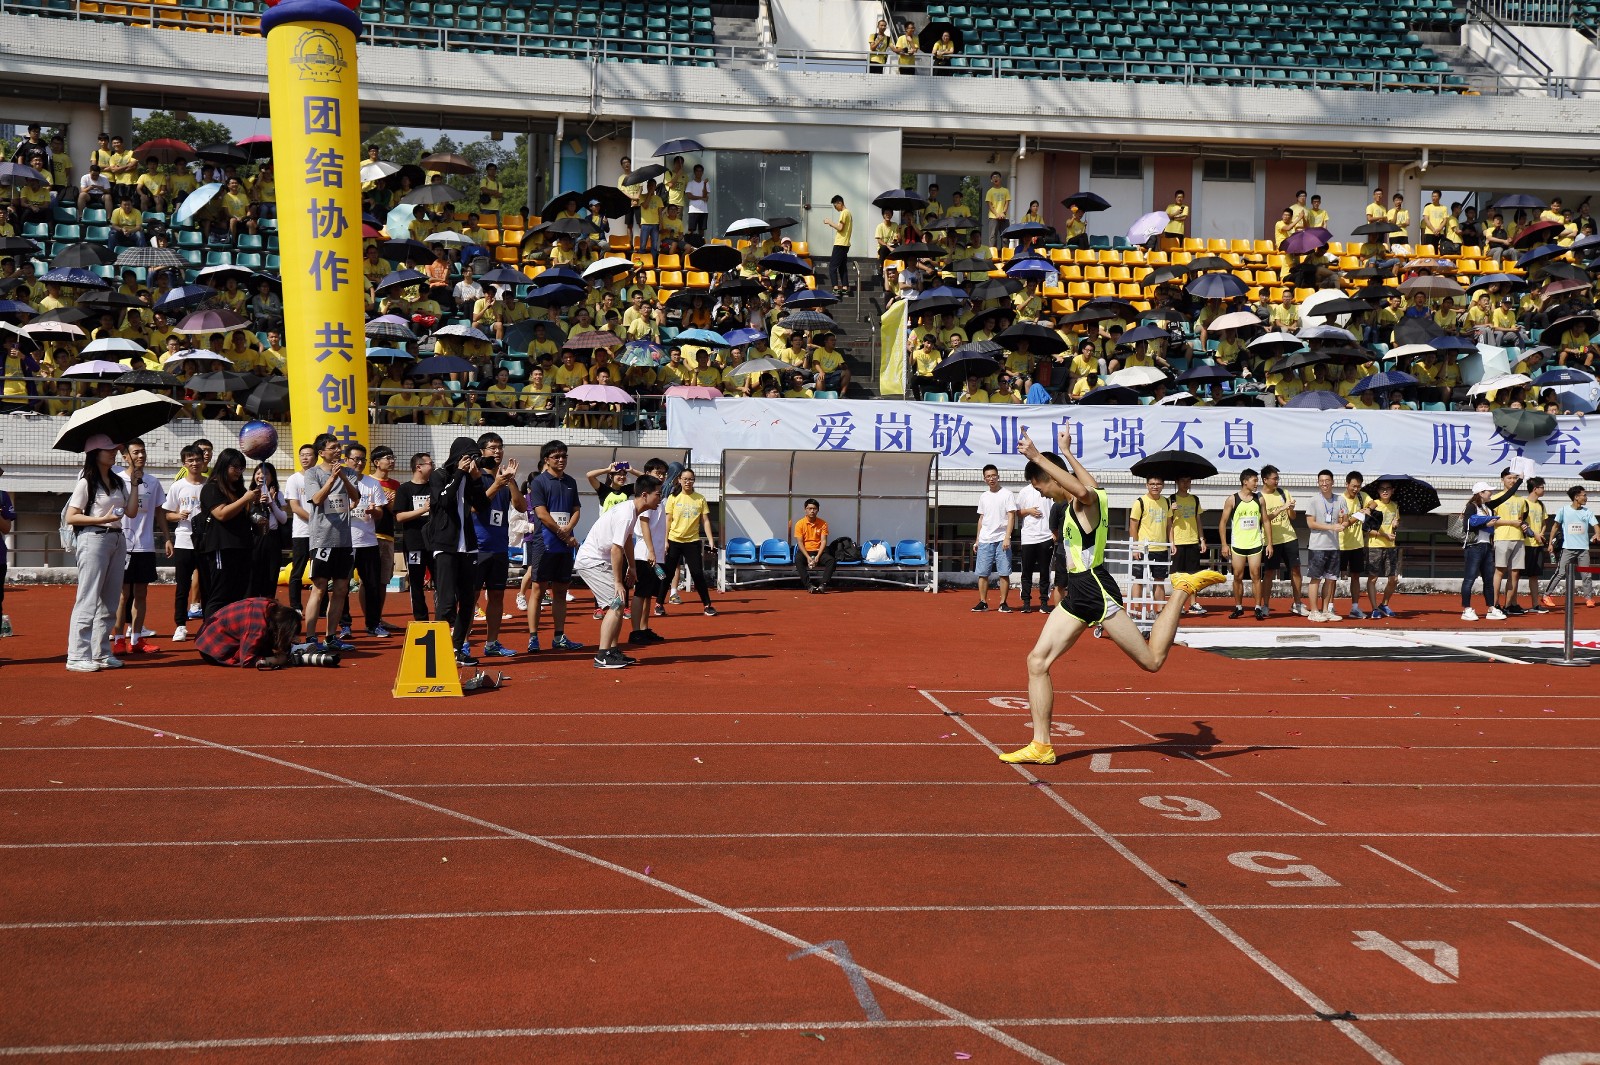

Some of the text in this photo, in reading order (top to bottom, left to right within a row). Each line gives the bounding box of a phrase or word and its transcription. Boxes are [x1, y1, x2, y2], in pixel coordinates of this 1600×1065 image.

[303, 96, 349, 291] 团结协作
[811, 411, 1260, 460] 爱岗敬业自强不息
[319, 547, 328, 559] 6
[410, 552, 418, 563] 4
[415, 630, 436, 678] 1
[1138, 795, 1222, 822] 6
[1227, 850, 1343, 888] 5
[1350, 930, 1460, 984] 4
